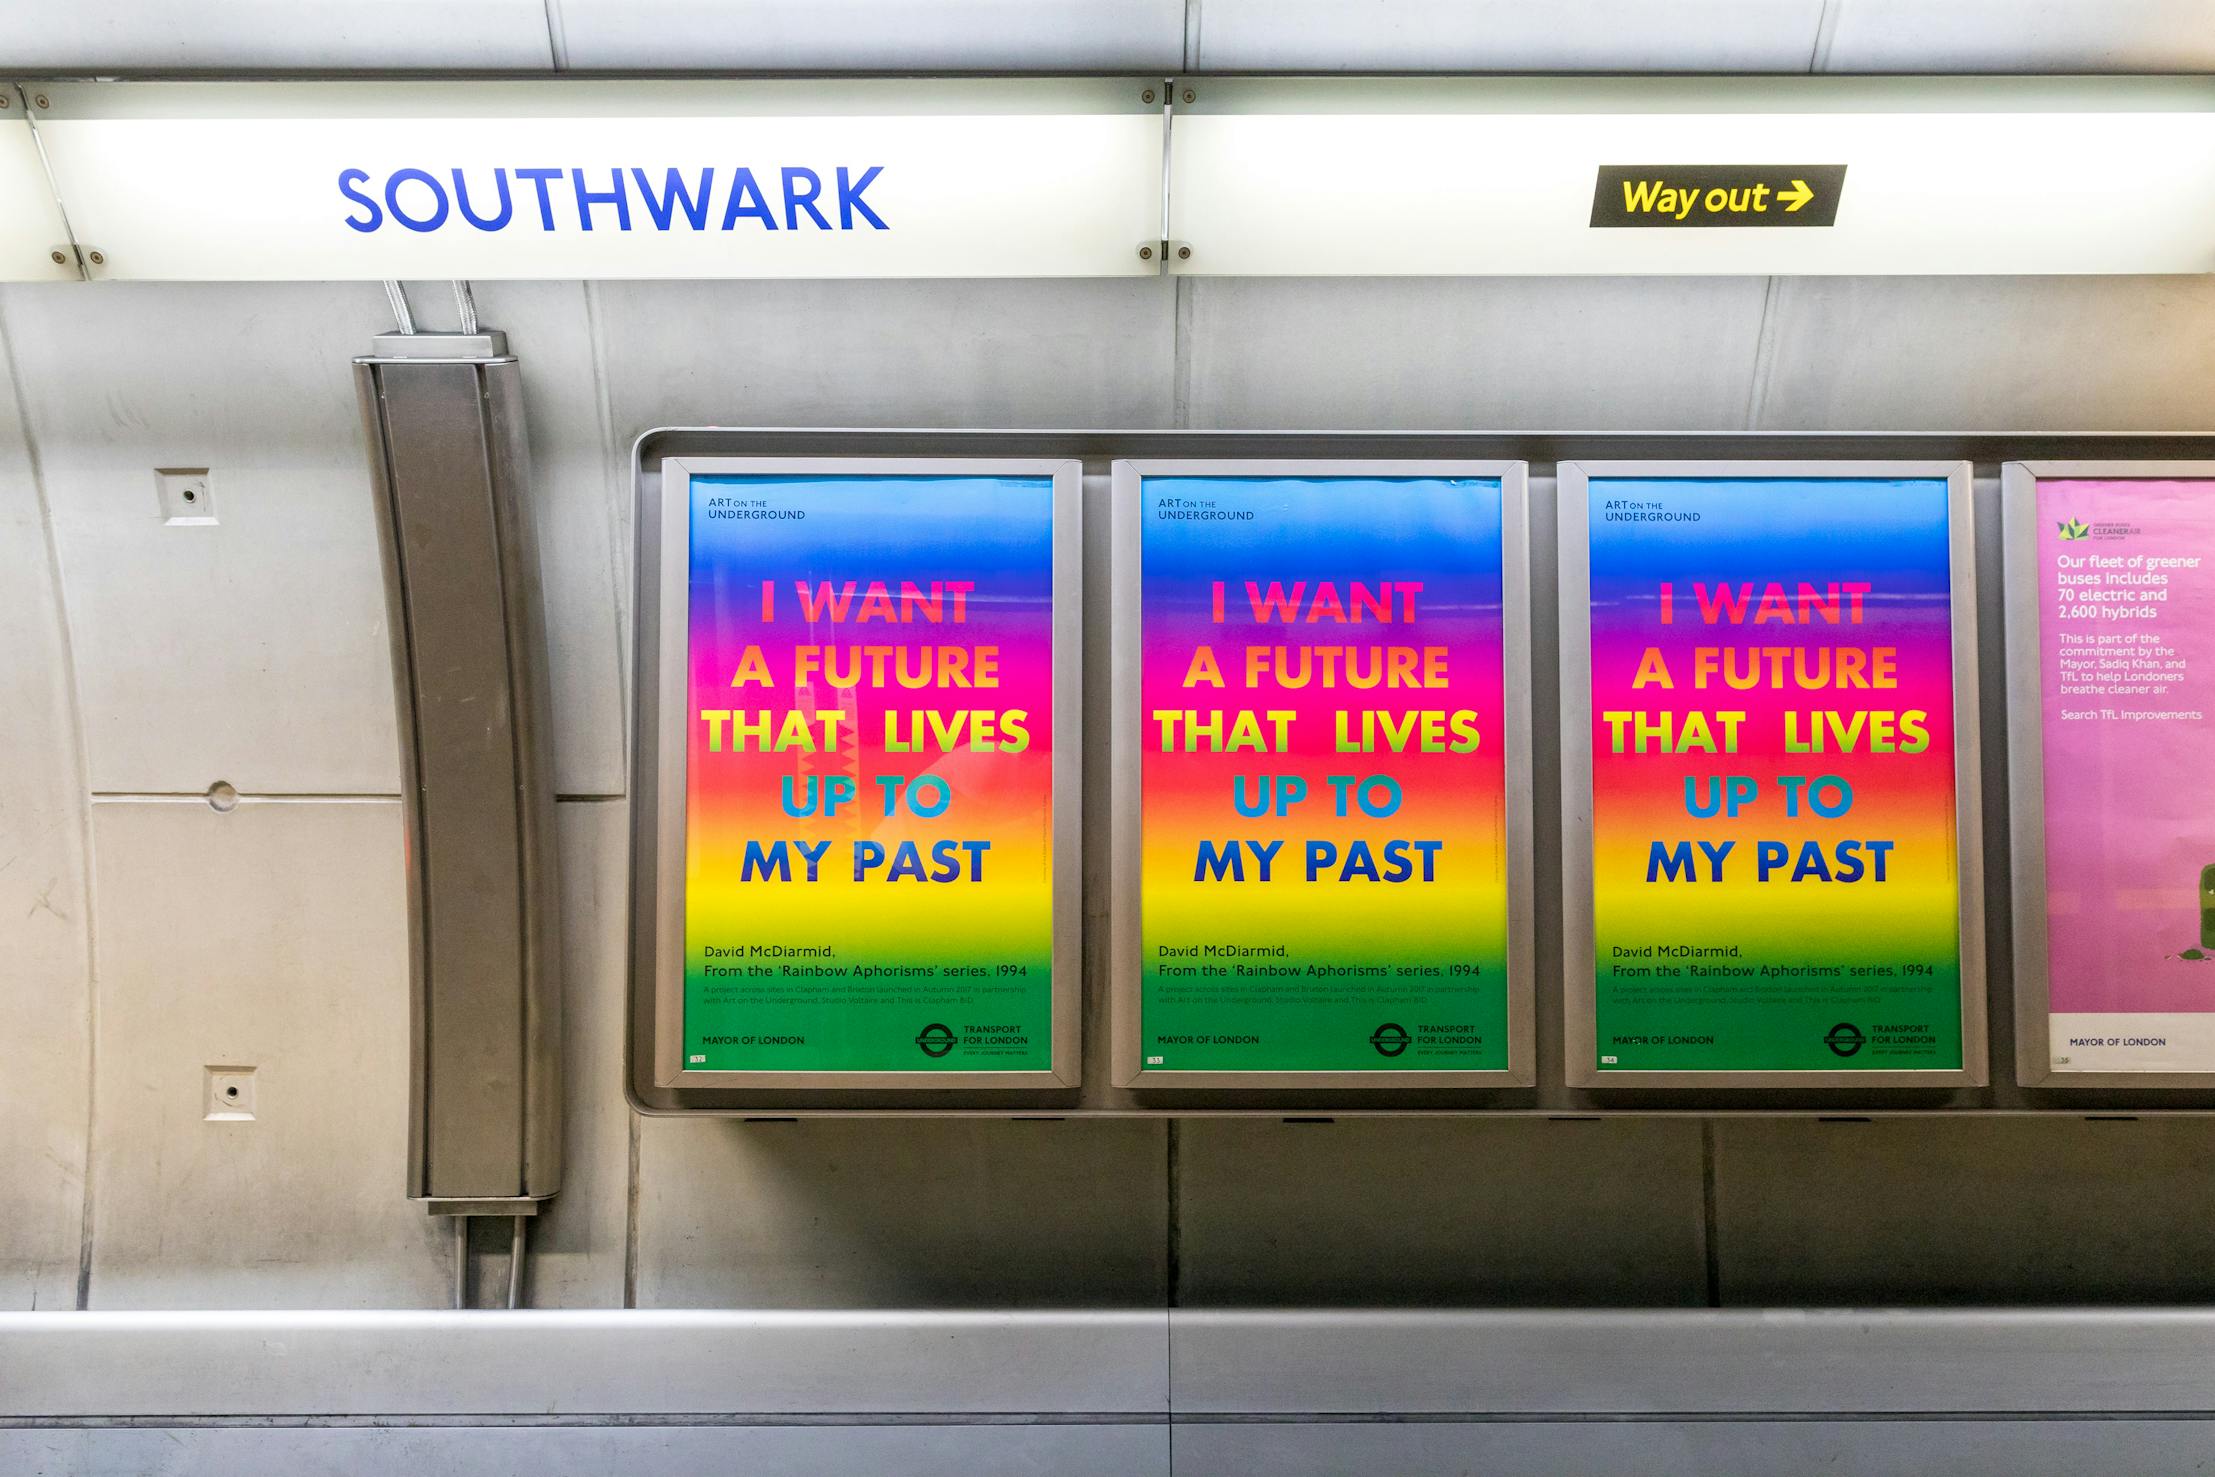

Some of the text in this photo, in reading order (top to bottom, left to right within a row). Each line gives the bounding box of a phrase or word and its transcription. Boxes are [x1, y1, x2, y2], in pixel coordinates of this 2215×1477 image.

[339, 167, 890, 233] SOUTHWARK
[1623, 181, 1769, 219] Way out
[709, 498, 731, 507] ART
[1159, 499, 1181, 508] ART
[1606, 501, 1628, 509] ART
[709, 510, 805, 519] UNDERGROUND
[1159, 511, 1254, 520] UNDERGROUND
[1606, 513, 1700, 522] UNDERGROUND
[2058, 556, 2201, 570] Our fleet of greener
[2058, 572, 2168, 584] buses includes
[2058, 589, 2167, 601] 70 electric and
[762, 581, 975, 623] I WANT
[1213, 582, 1424, 623] I WANT
[1660, 583, 1871, 625] I WANT
[2102, 605, 2156, 620] hybrids
[2060, 634, 2159, 646] This is part of the
[2060, 646, 2174, 658] commitment by the
[731, 646, 999, 688] A FUTURE
[1183, 646, 1449, 689] A FUTURE
[1632, 647, 1897, 689] A FUTURE
[2099, 659, 2129, 671] Sadiq
[2132, 659, 2162, 670] Khan,
[2165, 659, 2185, 668] and
[2061, 672, 2184, 683] TfL to help Londoners
[2061, 684, 2168, 694] breathe cleaner air.
[2061, 710, 2202, 722] Search TfL Improvements
[701, 710, 1030, 753] THAT LIVES
[1153, 710, 1480, 753] THAT LIVES
[1603, 710, 1930, 753] THAT LIVES
[782, 774, 951, 818] UP TO
[1234, 775, 1403, 818] UP TO
[1685, 775, 1853, 818] UP TO
[741, 840, 991, 883] MY PAST
[1194, 840, 1442, 882] MY PAST
[1647, 840, 1894, 883] MY PAST
[705, 946, 835, 959] David McDiarmid,
[1159, 945, 1288, 959] David McDiarmid,
[1613, 945, 1742, 959] David McDiarmid,
[705, 965, 742, 977] From
[748, 965, 773, 977] the
[996, 965, 1027, 977] 1994
[1159, 965, 1197, 976] From
[1202, 965, 1227, 976] the
[1449, 965, 1480, 976] 1994
[1613, 965, 1650, 977] From
[1656, 965, 1680, 977] the
[1903, 965, 1933, 976] 1994
[703, 1036, 804, 1044] MAYOR OF LONDON
[1158, 1036, 1259, 1044] MAYOR OF LONDON
[1417, 1036, 1435, 1044] FOR
[1439, 1036, 1481, 1044] LONDON
[1613, 1036, 1713, 1045] MAYOR OF LONDON
[1893, 1036, 1935, 1044] LONDON
